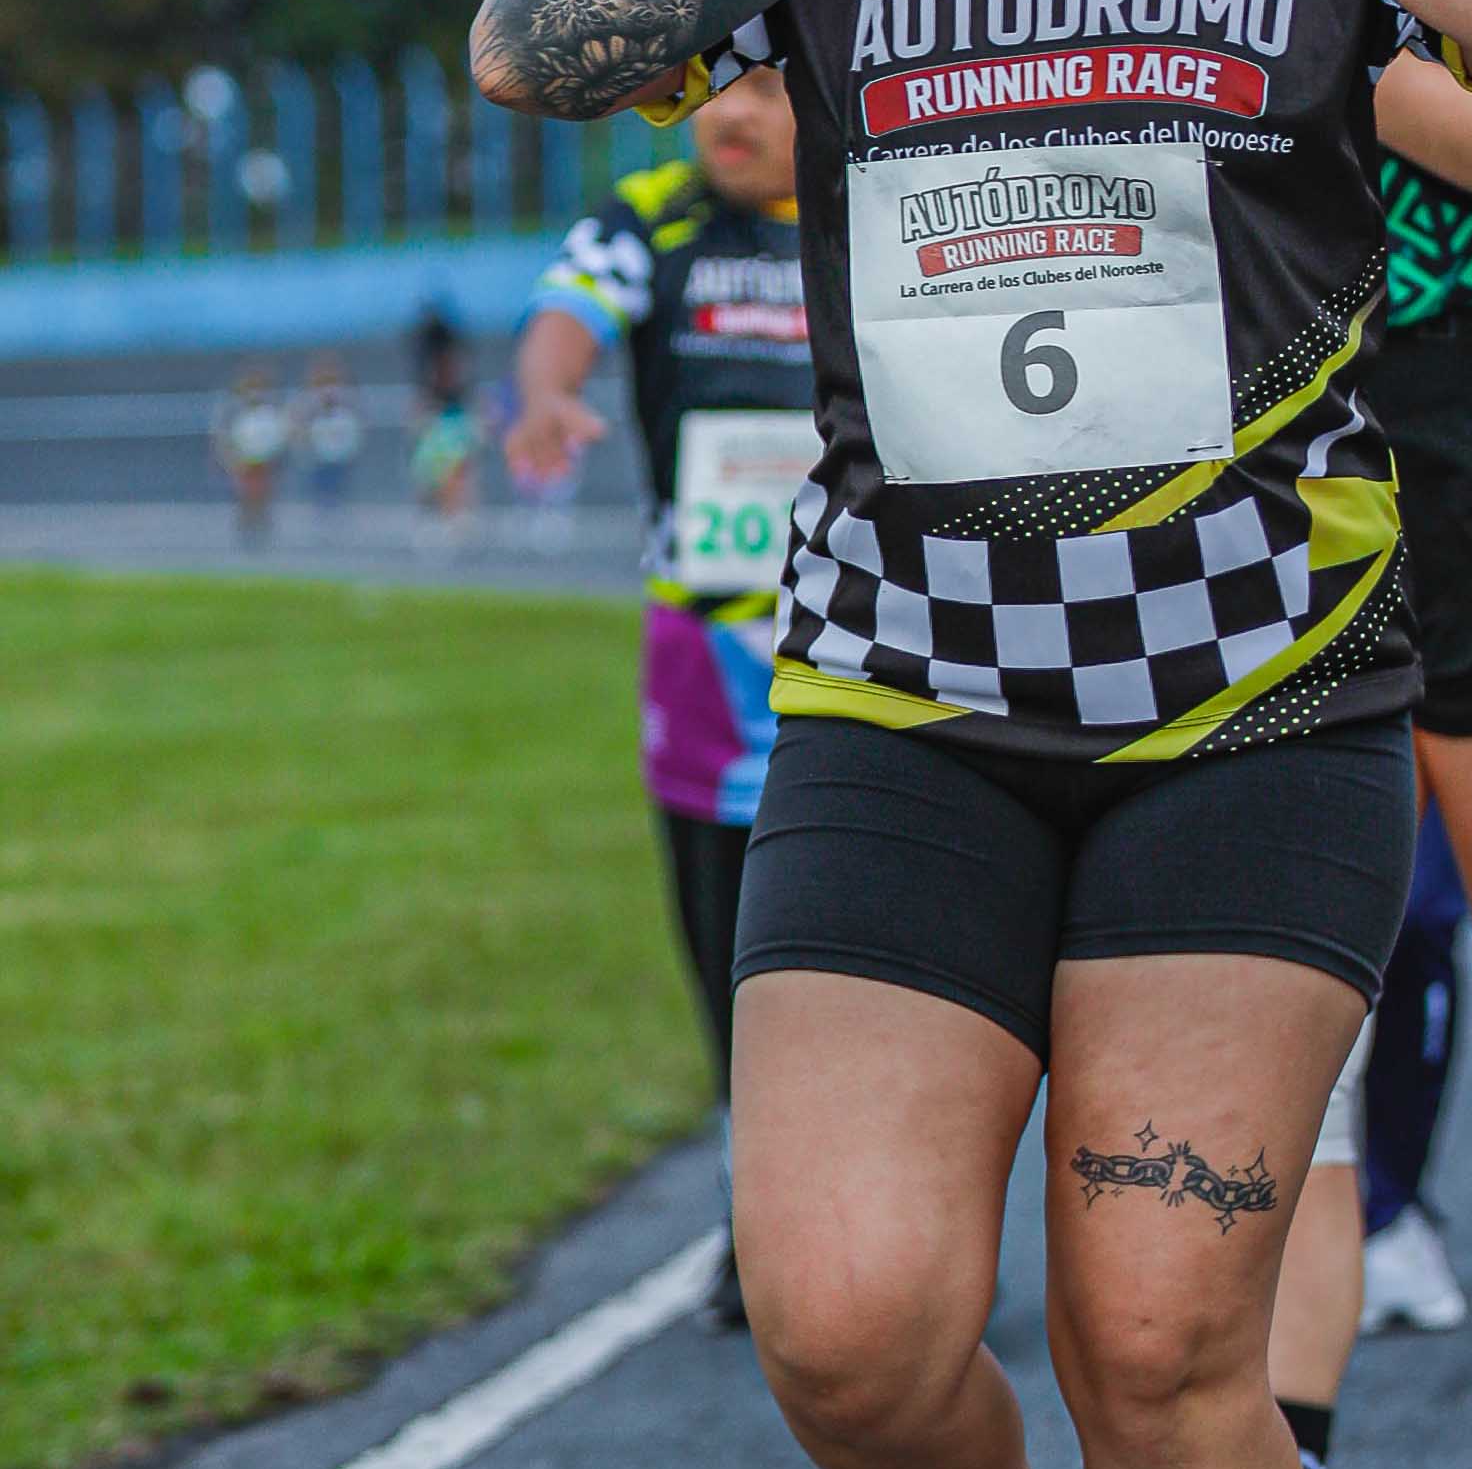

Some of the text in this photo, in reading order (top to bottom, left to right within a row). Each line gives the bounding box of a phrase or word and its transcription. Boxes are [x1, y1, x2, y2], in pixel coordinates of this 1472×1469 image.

[904, 52, 1222, 121] RUNNING RACE
[1139, 120, 1179, 144] del
[1186, 120, 1294, 154] Noroeste
[900, 166, 1158, 244] AUTÓDROMO
[941, 228, 1117, 270] RUNNING RACE
[900, 261, 1165, 299] La Carrera de los Clubes del Noroeste
[1000, 309, 1079, 416] 6
[691, 500, 789, 561] 20
